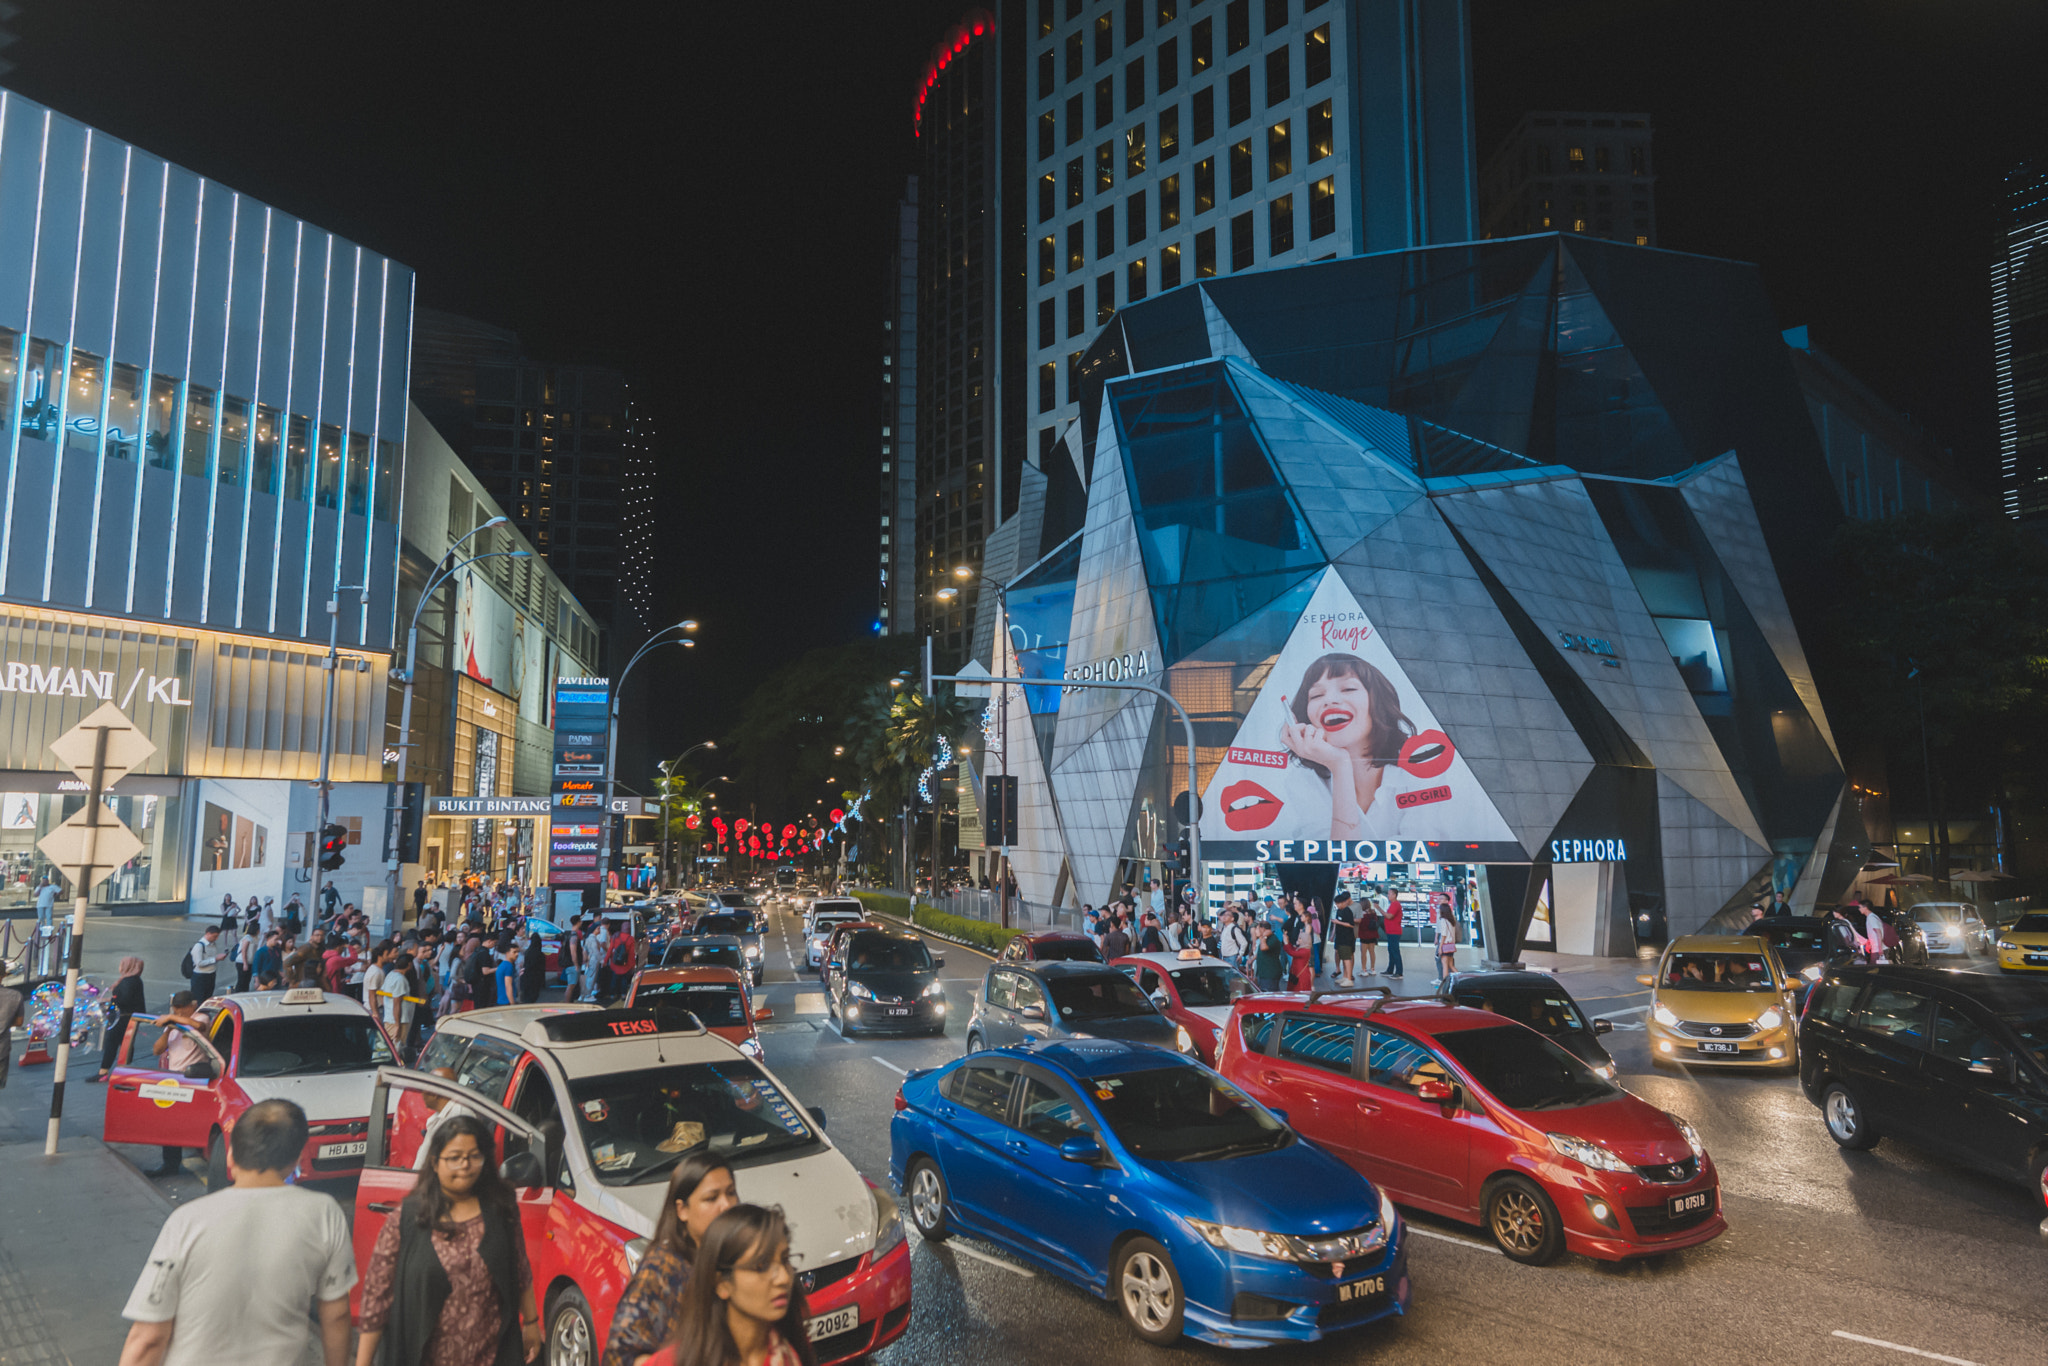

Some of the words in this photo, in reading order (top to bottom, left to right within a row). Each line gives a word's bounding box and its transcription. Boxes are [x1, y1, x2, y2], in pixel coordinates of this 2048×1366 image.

[1303, 612, 1365, 624] SEPHORA
[1320, 619, 1373, 650] Rouge
[558, 676, 609, 686] PAVILION
[1063, 650, 1148, 695] SEPHORA
[147, 676, 191, 706] KL
[1231, 750, 1284, 766] FEARLESS
[562, 780, 594, 790] Mercato
[1398, 793, 1418, 805] GO
[1420, 788, 1448, 801] GIRL!
[438, 800, 483, 811] BUKIT
[486, 800, 551, 811] BINTANG
[553, 841, 598, 851] foodrepublic
[1255, 840, 1431, 863] SEPHORA
[1551, 839, 1627, 863] SEPHORA
[608, 1019, 658, 1036] TEKSI
[329, 1145, 348, 1156] HBA
[1685, 1195, 1700, 1210] 8751
[1353, 1279, 1376, 1298] 7170
[1376, 1276, 1385, 1292] G
[817, 1312, 850, 1337] 2092
